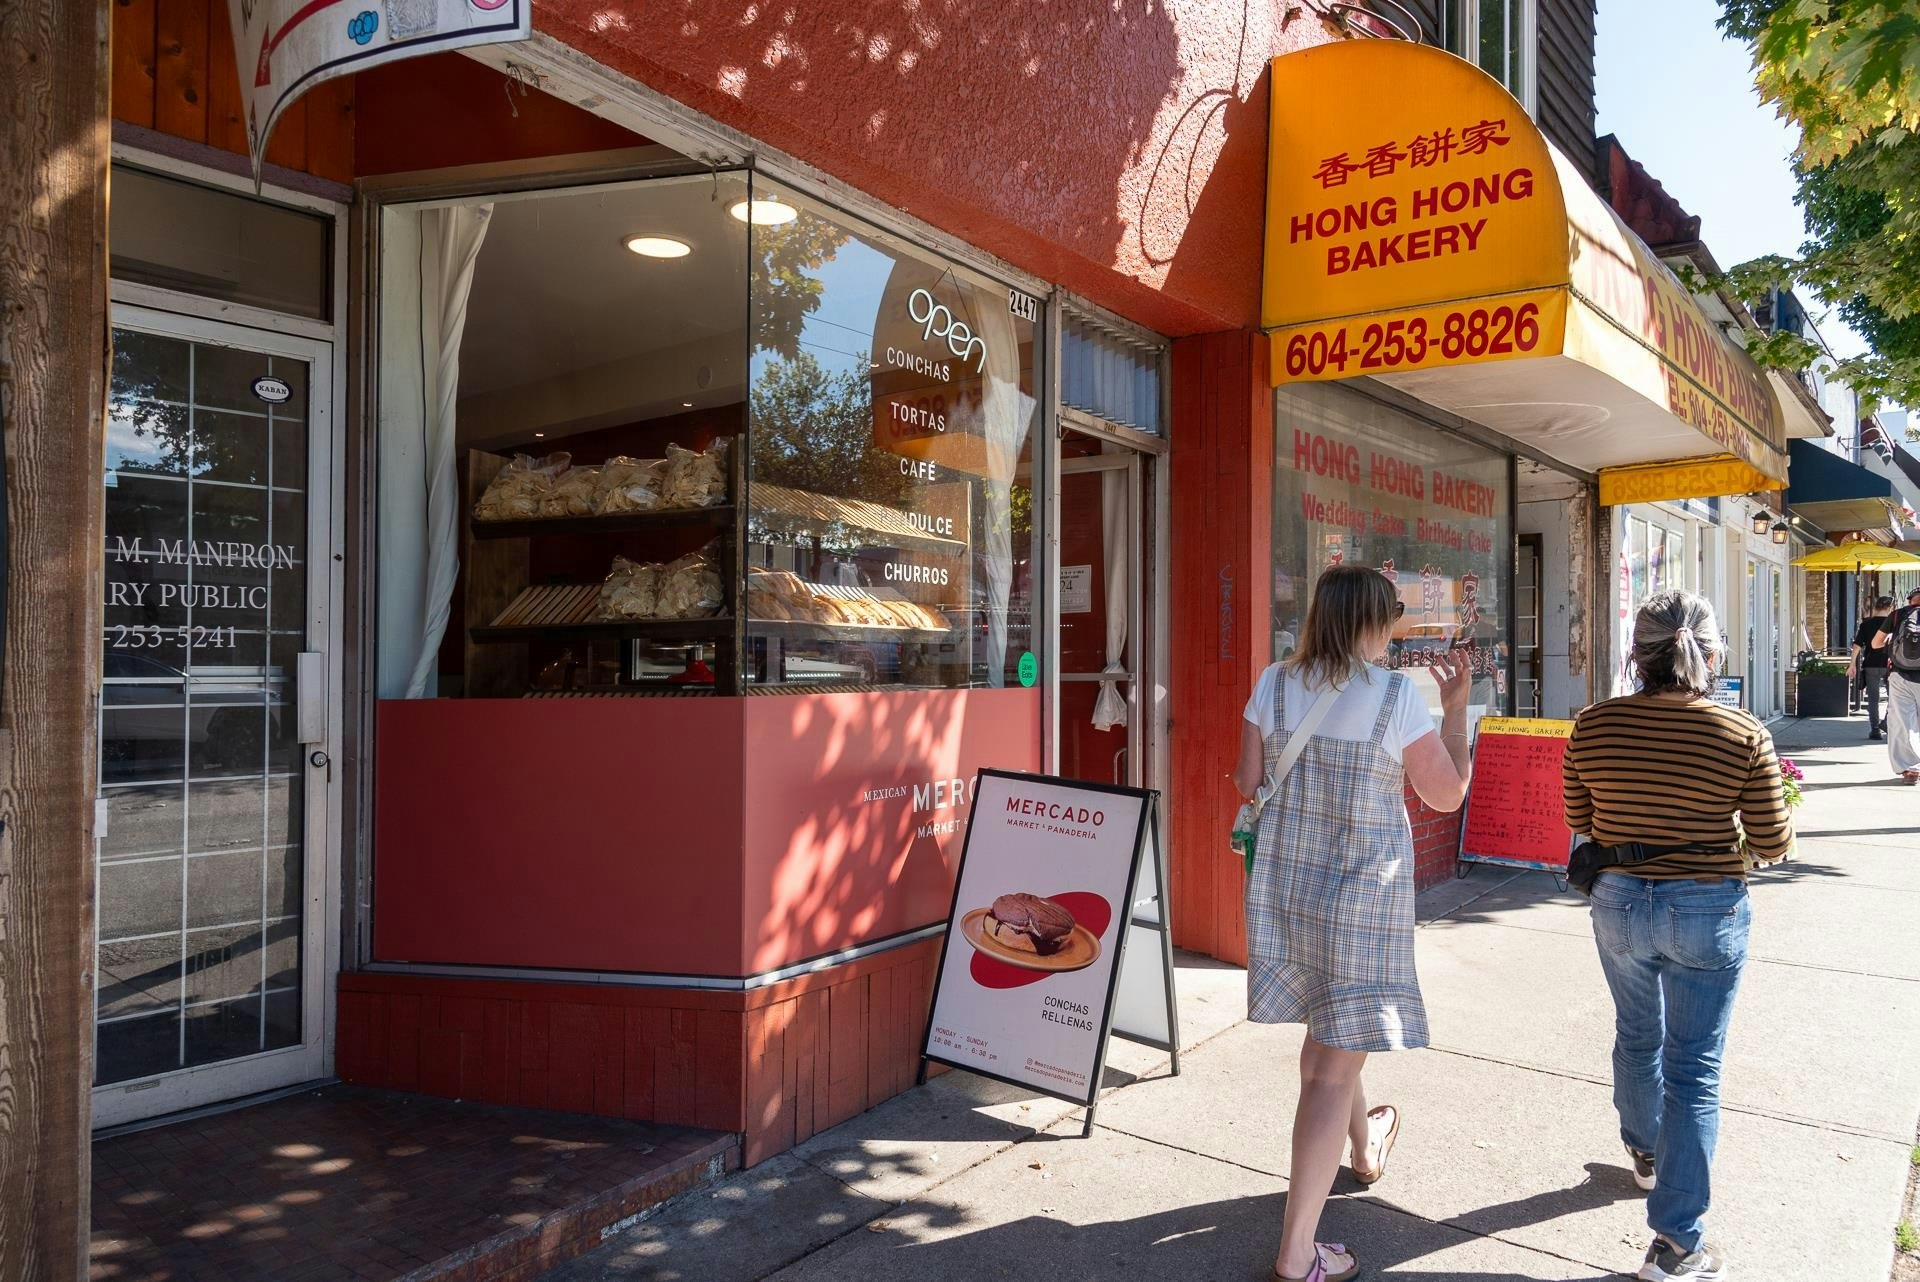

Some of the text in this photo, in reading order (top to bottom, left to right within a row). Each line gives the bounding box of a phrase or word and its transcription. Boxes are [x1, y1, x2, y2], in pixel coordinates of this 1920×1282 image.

[1312, 118, 1511, 190] 香香餅家
[1290, 168, 1534, 244] HONG HONG
[1327, 218, 1488, 276] BAKERY
[1010, 291, 1036, 320] 2447
[1286, 302, 1540, 377] 604-253-8826
[1667, 295, 1725, 399] HONG
[887, 346, 950, 382] CONCHAS
[258, 385, 287, 394] KABAN
[891, 401, 946, 432] TORTAS
[900, 460, 936, 482] CAFÉ
[1294, 429, 1496, 518] HONG HONG BAKERY
[1302, 491, 1367, 536] Wedding
[1372, 505, 1406, 537] Cake
[1416, 517, 1464, 552] Birthday
[1468, 529, 1492, 555] Cake
[114, 536, 295, 571] M. MANFRON
[884, 562, 948, 586] CHURROS
[104, 582, 268, 610] RY PUBLIC
[1022, 671, 1033, 679] Eats
[1534, 728, 1565, 736] BAKERY
[863, 786, 908, 802] MEXICAN
[1006, 797, 1105, 827] MERCADO
[917, 820, 961, 839] MARKET
[1006, 818, 1039, 830] MARKET
[1047, 825, 1097, 840] PANADERÍA
[1044, 996, 1089, 1015] CONCHAS
[1041, 1010, 1093, 1031] RELLENAS
[934, 1036, 952, 1047] 10:00
[971, 1047, 987, 1057] 6:30
[935, 1027, 957, 1038] MONDAY
[966, 1036, 989, 1048] SUNDAY
